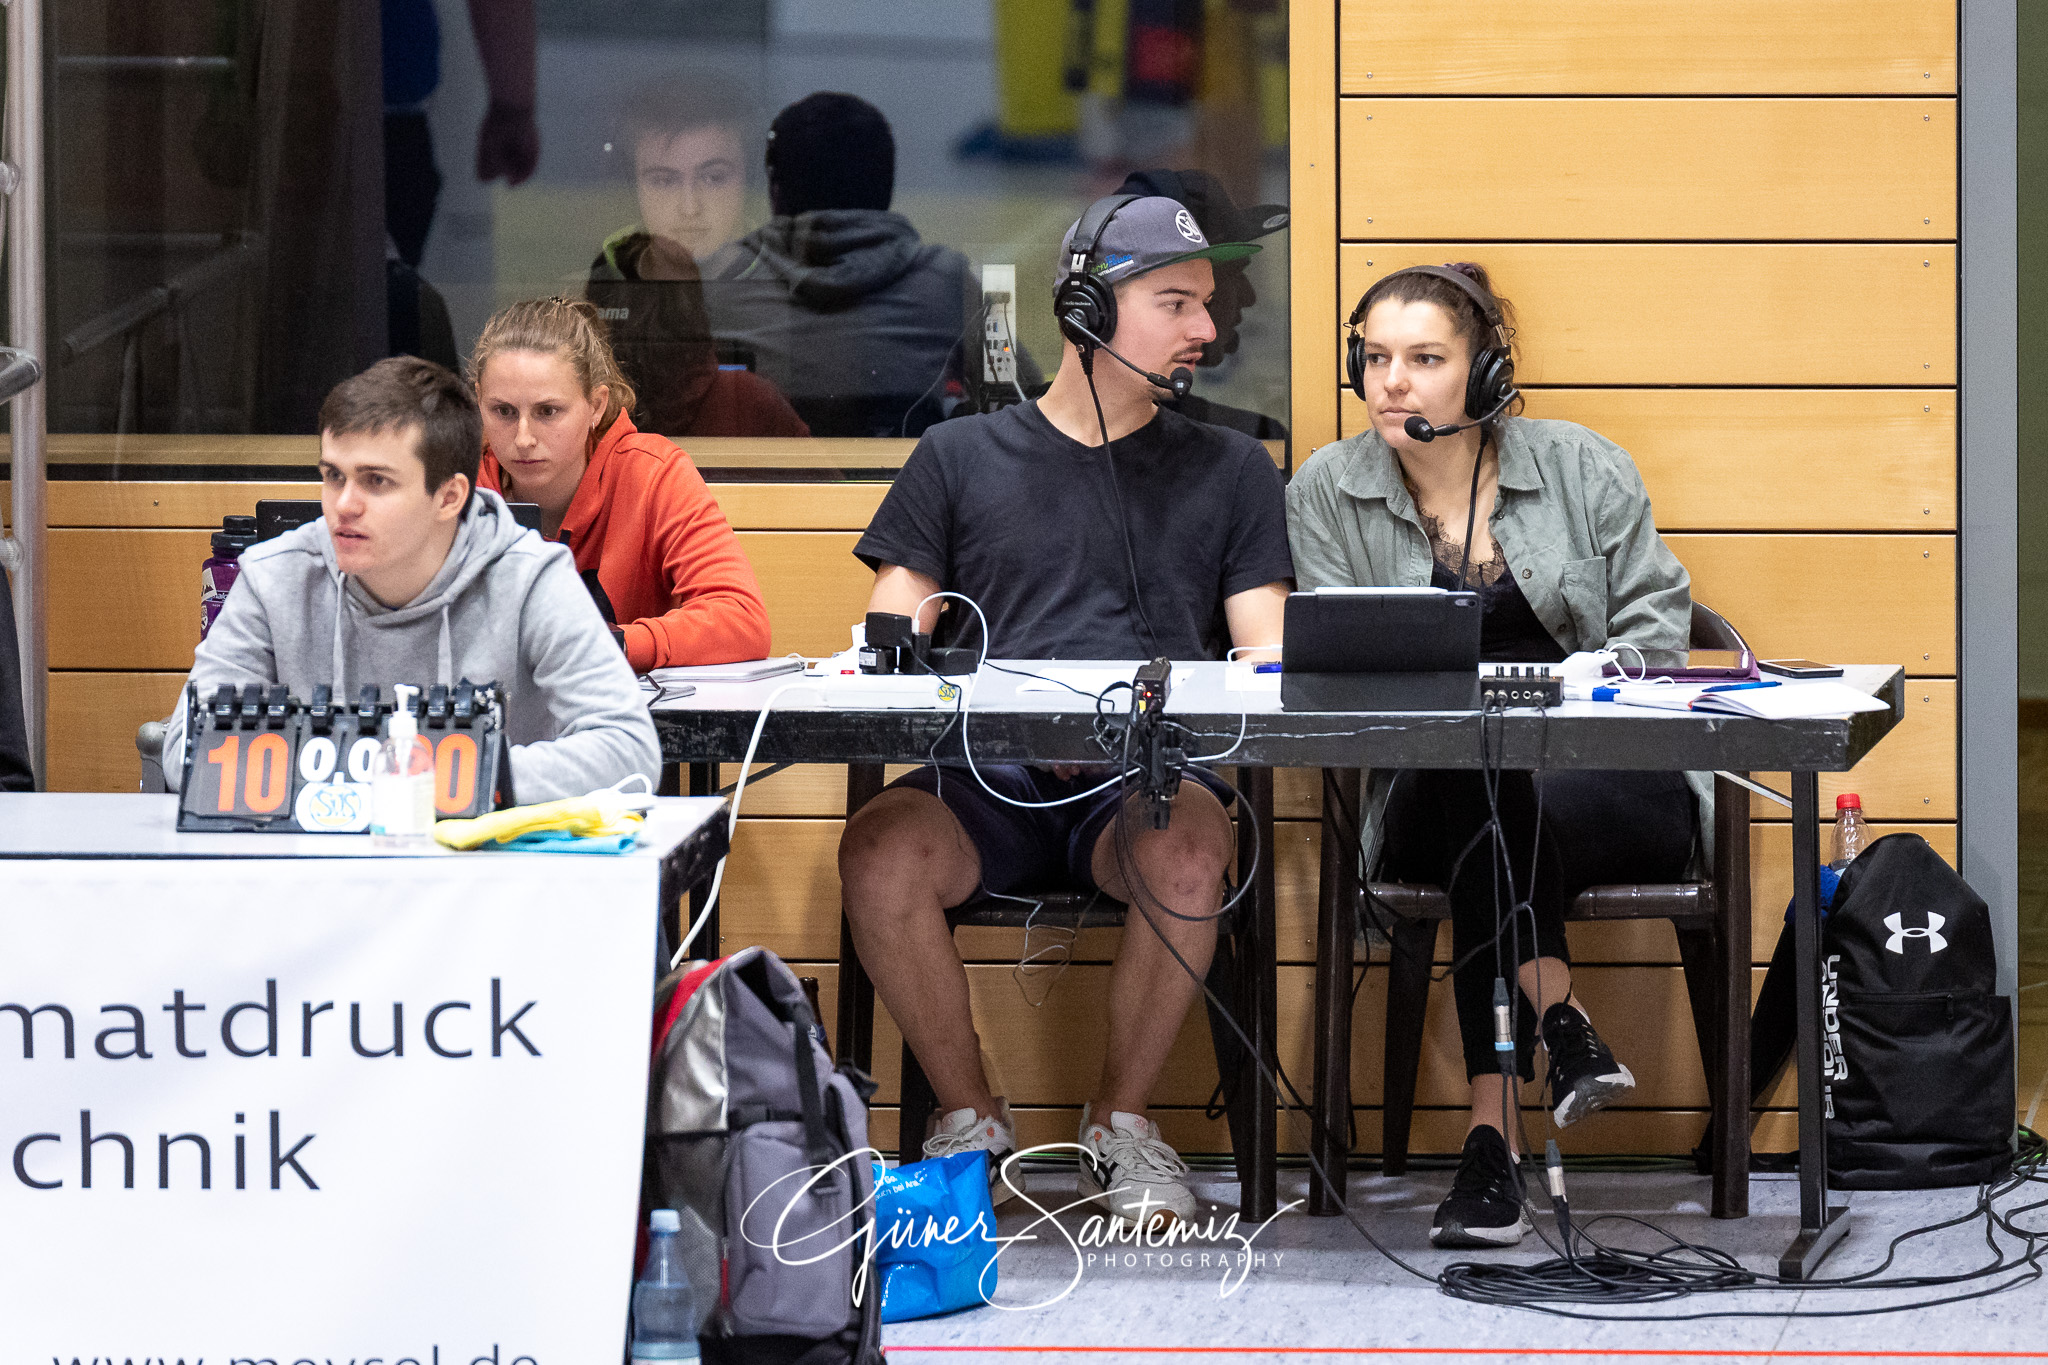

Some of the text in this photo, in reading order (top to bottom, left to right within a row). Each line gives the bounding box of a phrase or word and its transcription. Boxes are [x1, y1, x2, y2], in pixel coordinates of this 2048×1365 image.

[207, 733, 289, 812] 10
[0, 978, 542, 1059] matdruck
[1825, 954, 1849, 1081] UNDER
[12, 1109, 320, 1190] chnik
